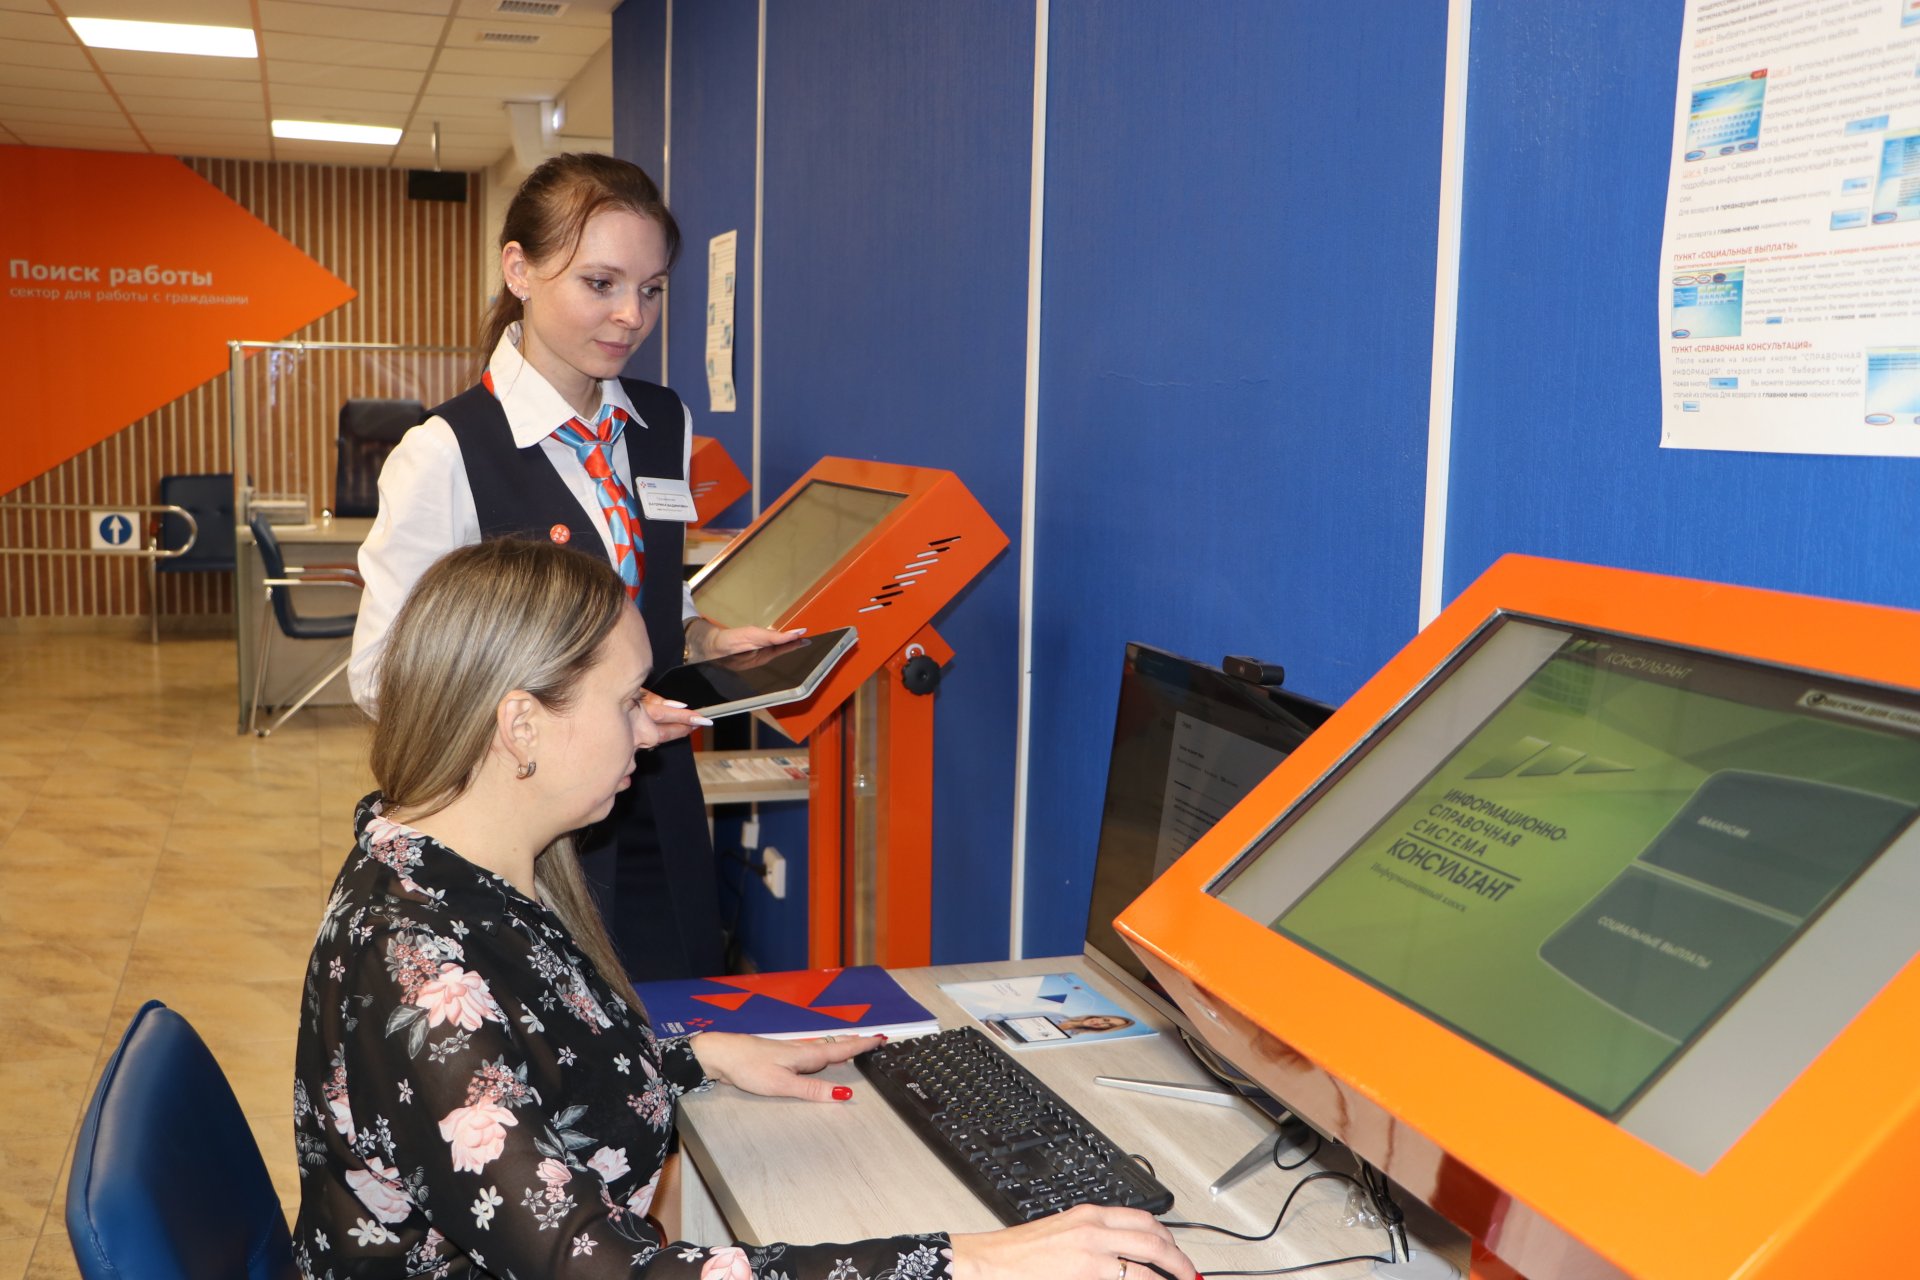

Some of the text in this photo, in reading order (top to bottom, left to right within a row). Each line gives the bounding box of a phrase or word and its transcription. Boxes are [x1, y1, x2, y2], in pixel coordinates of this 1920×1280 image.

[1720, 198, 1760, 212] предыдущее
[1760, 195, 1778, 204] меню
[1717, 225, 1741, 236] главное
[1742, 222, 1760, 232] меню
[1673, 252, 1697, 263] ПУНКТ
[9, 258, 213, 287] Поиск работы
[9, 287, 249, 306] сектор для работы с гражданами
[1671, 344, 1693, 354] ПУНКТ
[1762, 390, 1788, 399] главное
[1789, 390, 1808, 399] меню
[1604, 651, 1693, 680] КОНСУЛЬТАНТ
[1428, 803, 1522, 848] СПРАВОЧНАЯ
[1443, 788, 1567, 842] ИНФОРМАЦИОННО-
[1412, 819, 1490, 858] СИСТЕМА
[1386, 837, 1517, 903] КОНСУЛЬТАНТ
